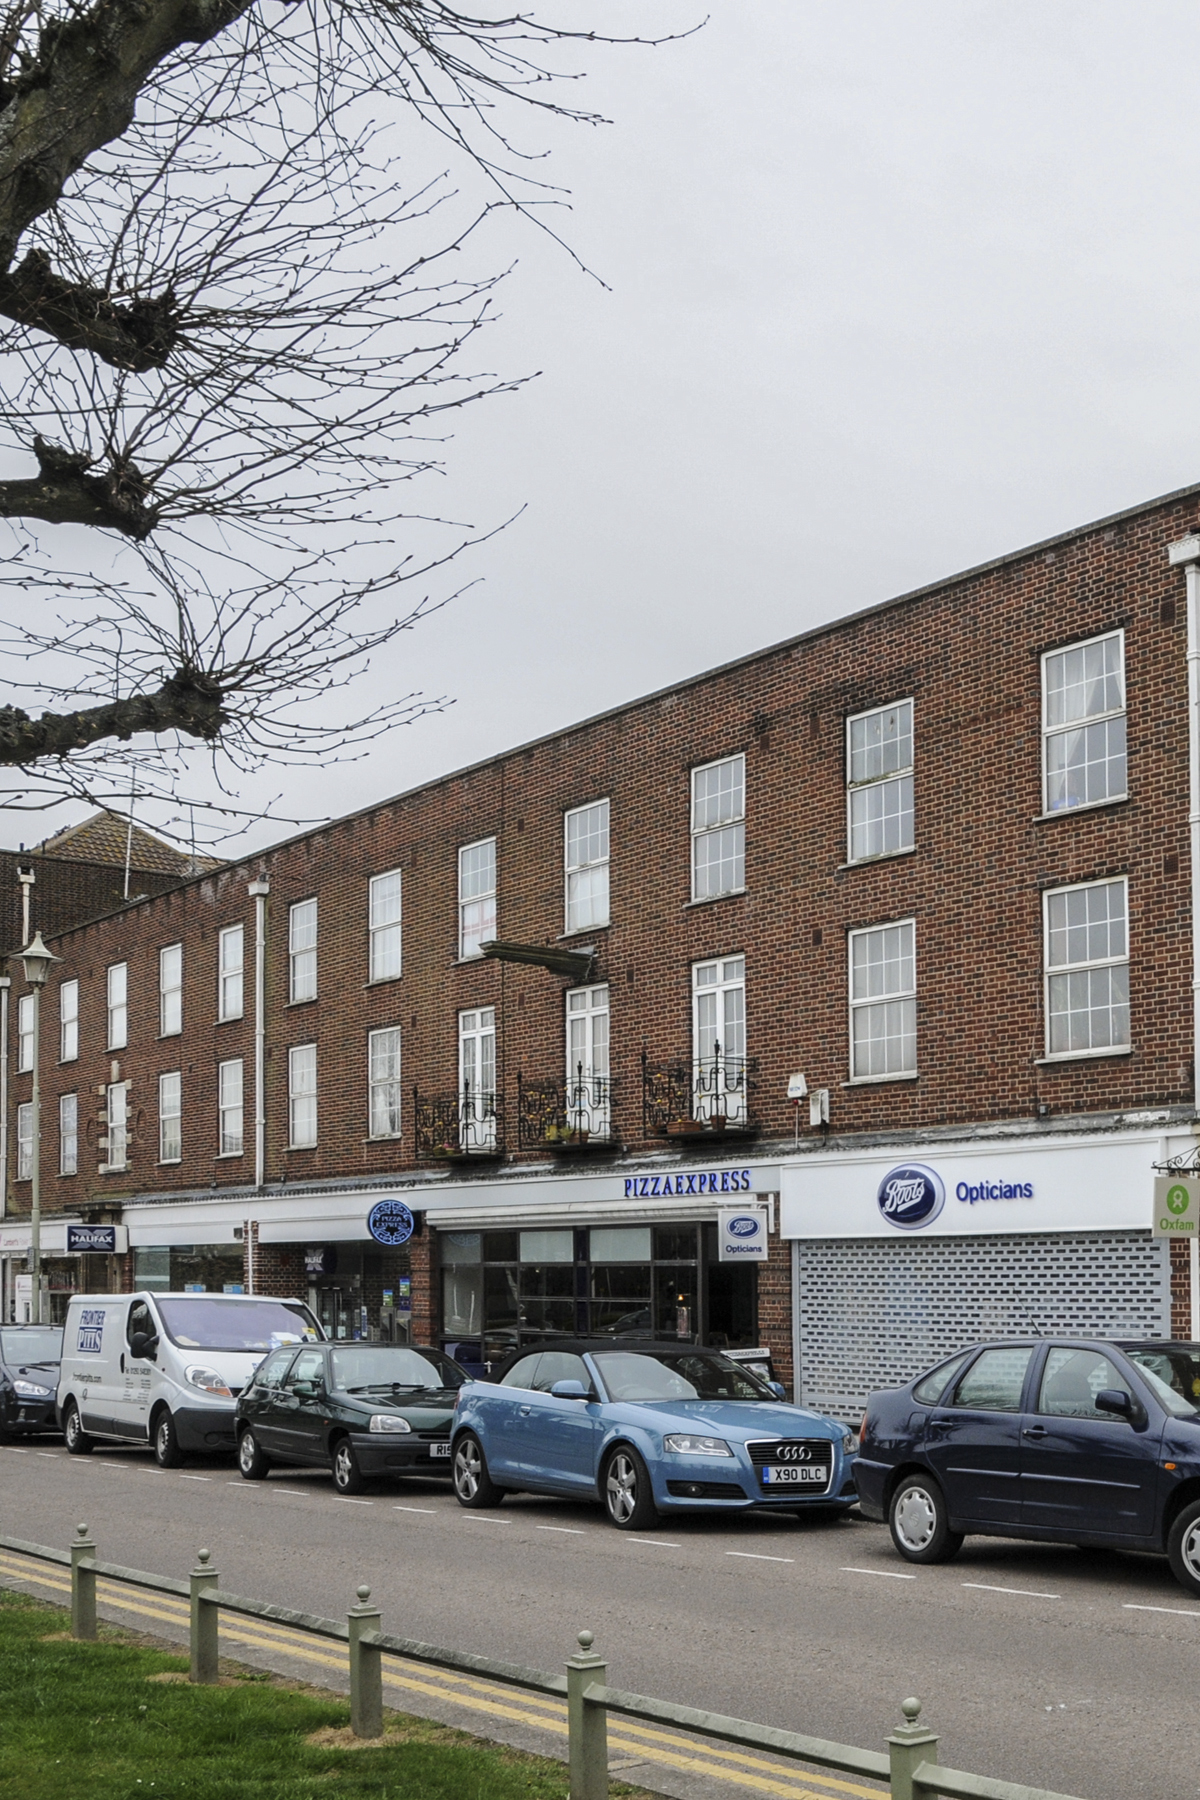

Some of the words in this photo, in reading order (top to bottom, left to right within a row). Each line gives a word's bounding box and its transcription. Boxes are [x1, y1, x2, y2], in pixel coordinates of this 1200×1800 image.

[624, 1170, 751, 1198] PIZZAEXPRESS
[882, 1177, 925, 1213] Boots
[955, 1179, 1034, 1205] Opticians
[1160, 1218, 1194, 1231] Oxfam
[70, 1235, 113, 1243] HALIFAX
[725, 1244, 762, 1254] Opticians
[80, 1310, 106, 1325] FRONTIER
[775, 1468, 798, 1481] X90
[801, 1468, 822, 1481] DLC
